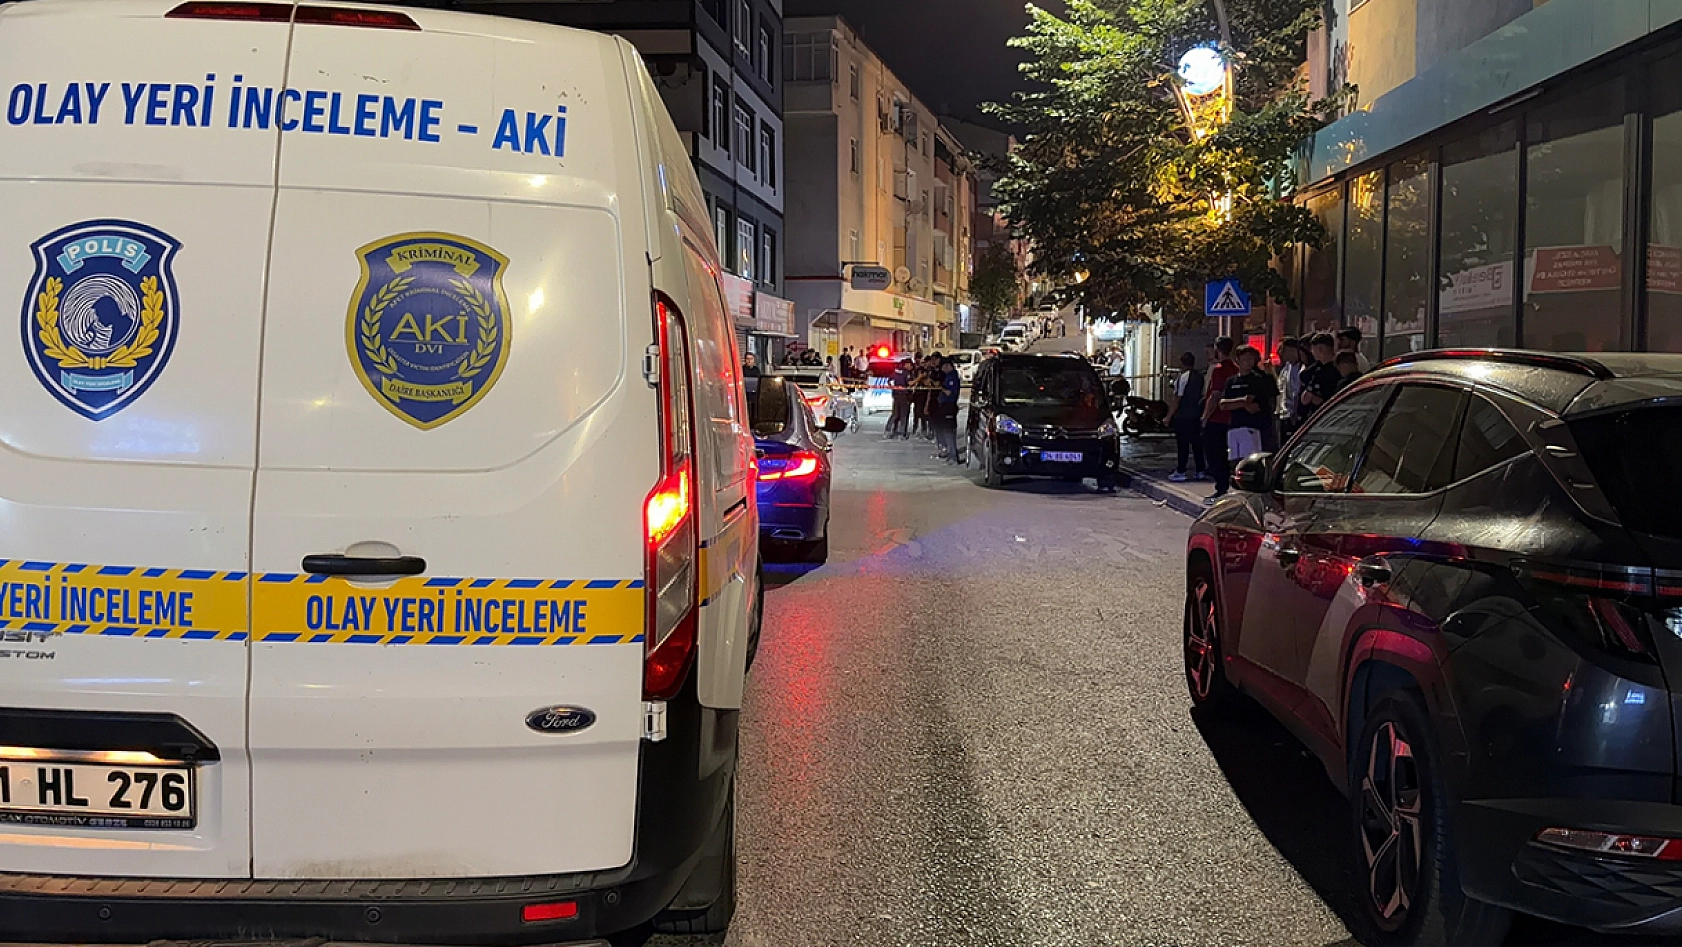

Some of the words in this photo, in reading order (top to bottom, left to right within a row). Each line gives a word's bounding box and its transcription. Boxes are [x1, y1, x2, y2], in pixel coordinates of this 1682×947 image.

[7, 82, 110, 126] OLAY
[121, 72, 216, 128] YERİ
[227, 73, 443, 143] İNCELEME
[492, 105, 567, 157] AKİ
[67, 238, 139, 259] POLİS
[397, 247, 471, 265] KRİMİNAL
[389, 312, 468, 343] AKİ
[415, 343, 443, 354] DVI
[60, 576, 193, 627] İNCELEME
[306, 595, 377, 631] OLAY
[385, 589, 444, 633] YERİ
[454, 589, 587, 634] İNCELEME
[541, 713, 580, 728] Ford
[38, 768, 89, 806] HL
[107, 771, 185, 811] 276
